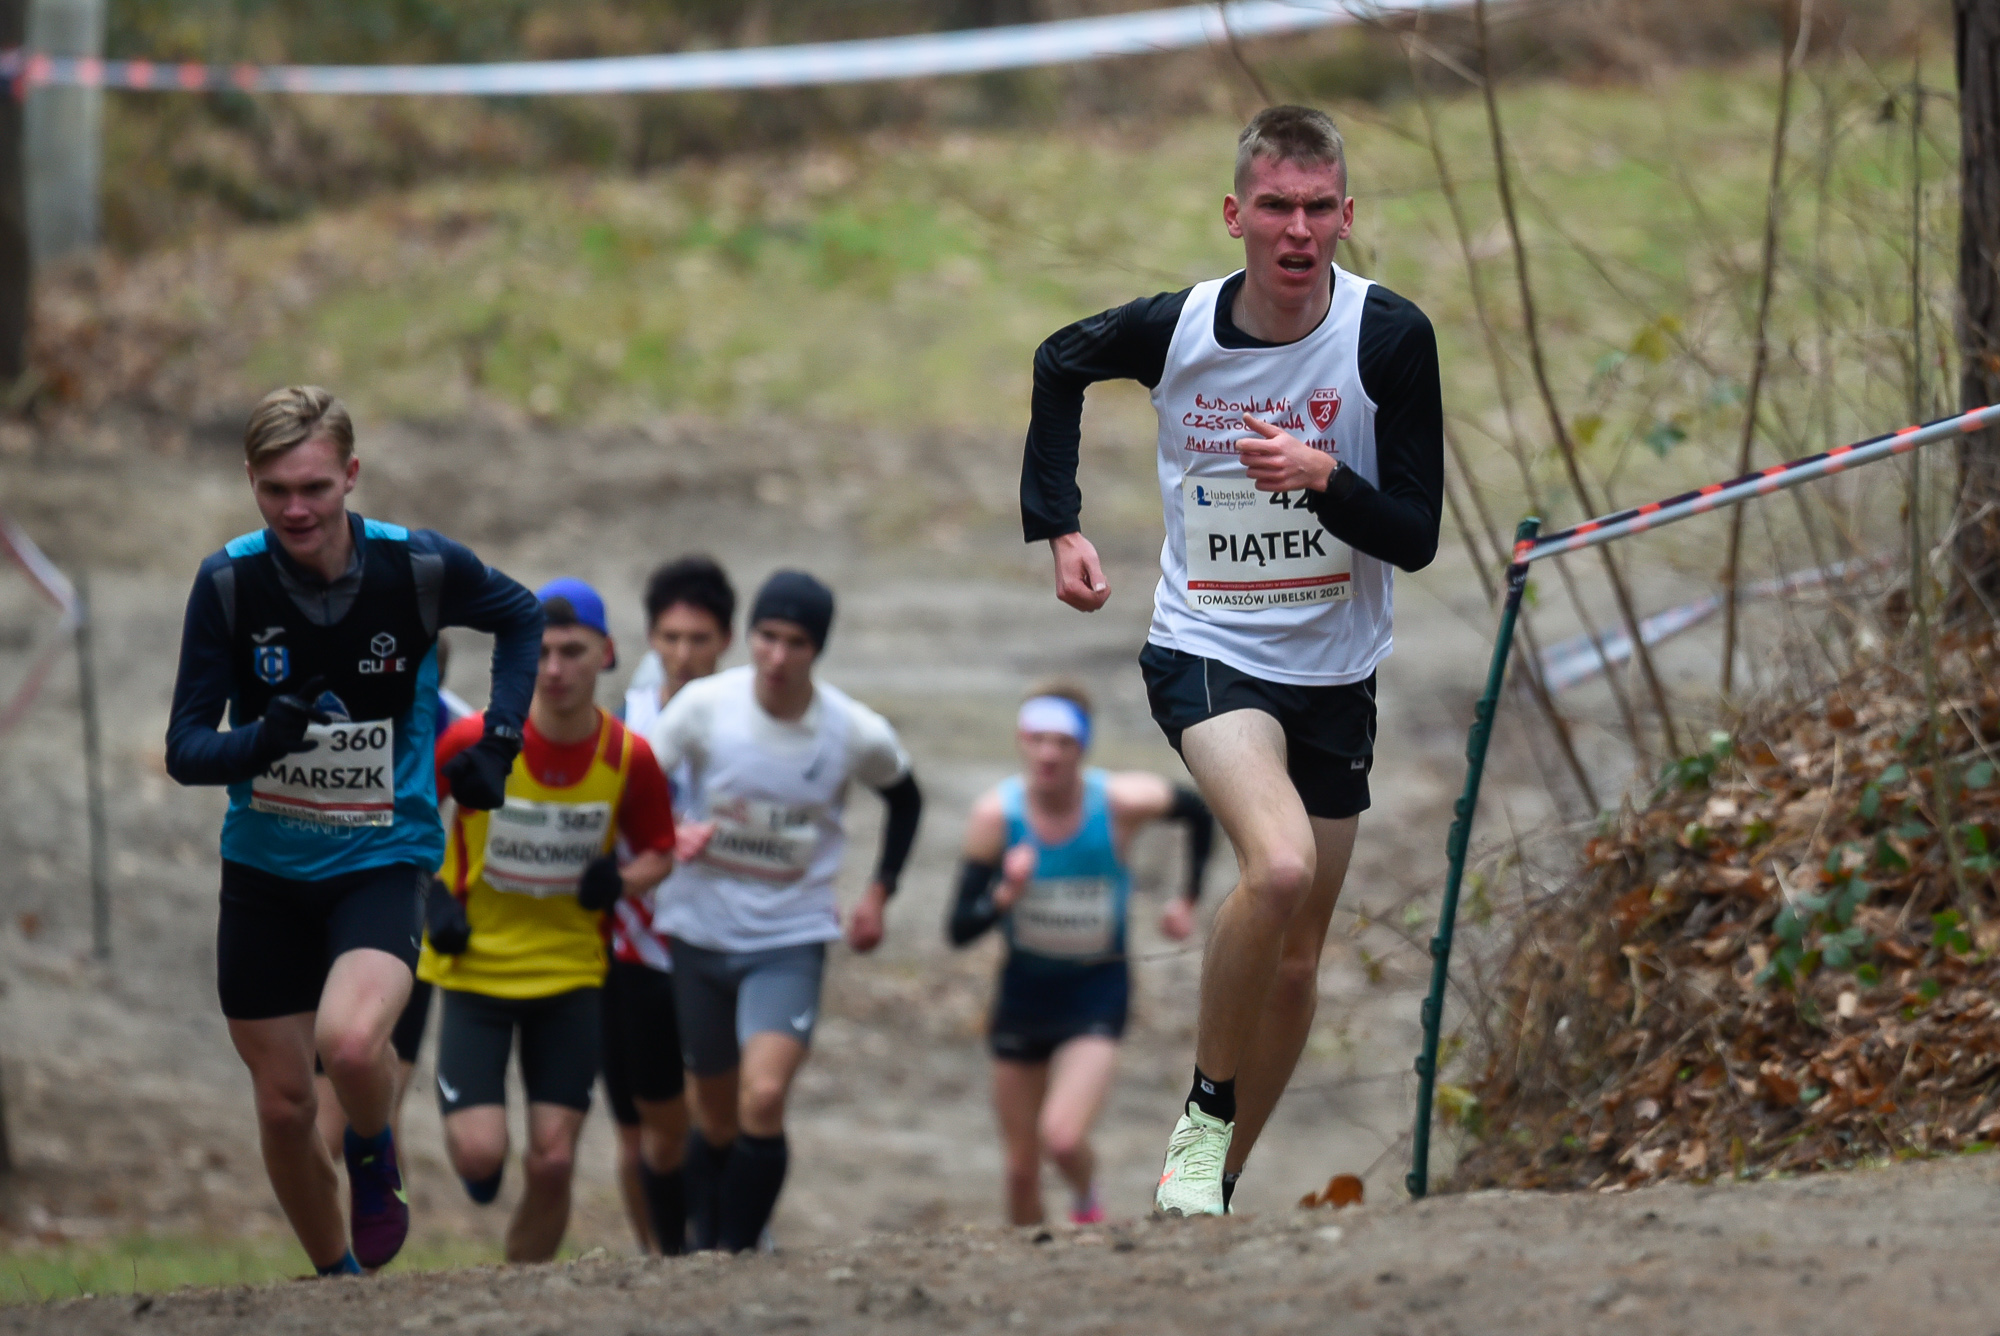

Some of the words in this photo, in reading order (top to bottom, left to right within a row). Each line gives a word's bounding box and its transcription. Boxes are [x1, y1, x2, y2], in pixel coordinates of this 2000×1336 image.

[1316, 391, 1334, 399] CKS
[1210, 489, 1256, 500] lubelskie
[1208, 528, 1327, 567] PIĄTEK
[1197, 593, 1264, 605] TOMASZÓW
[1268, 590, 1317, 604] LUBELSKI
[1320, 586, 1345, 598] 2021
[330, 727, 387, 752] 360
[263, 764, 385, 789] MARSZK
